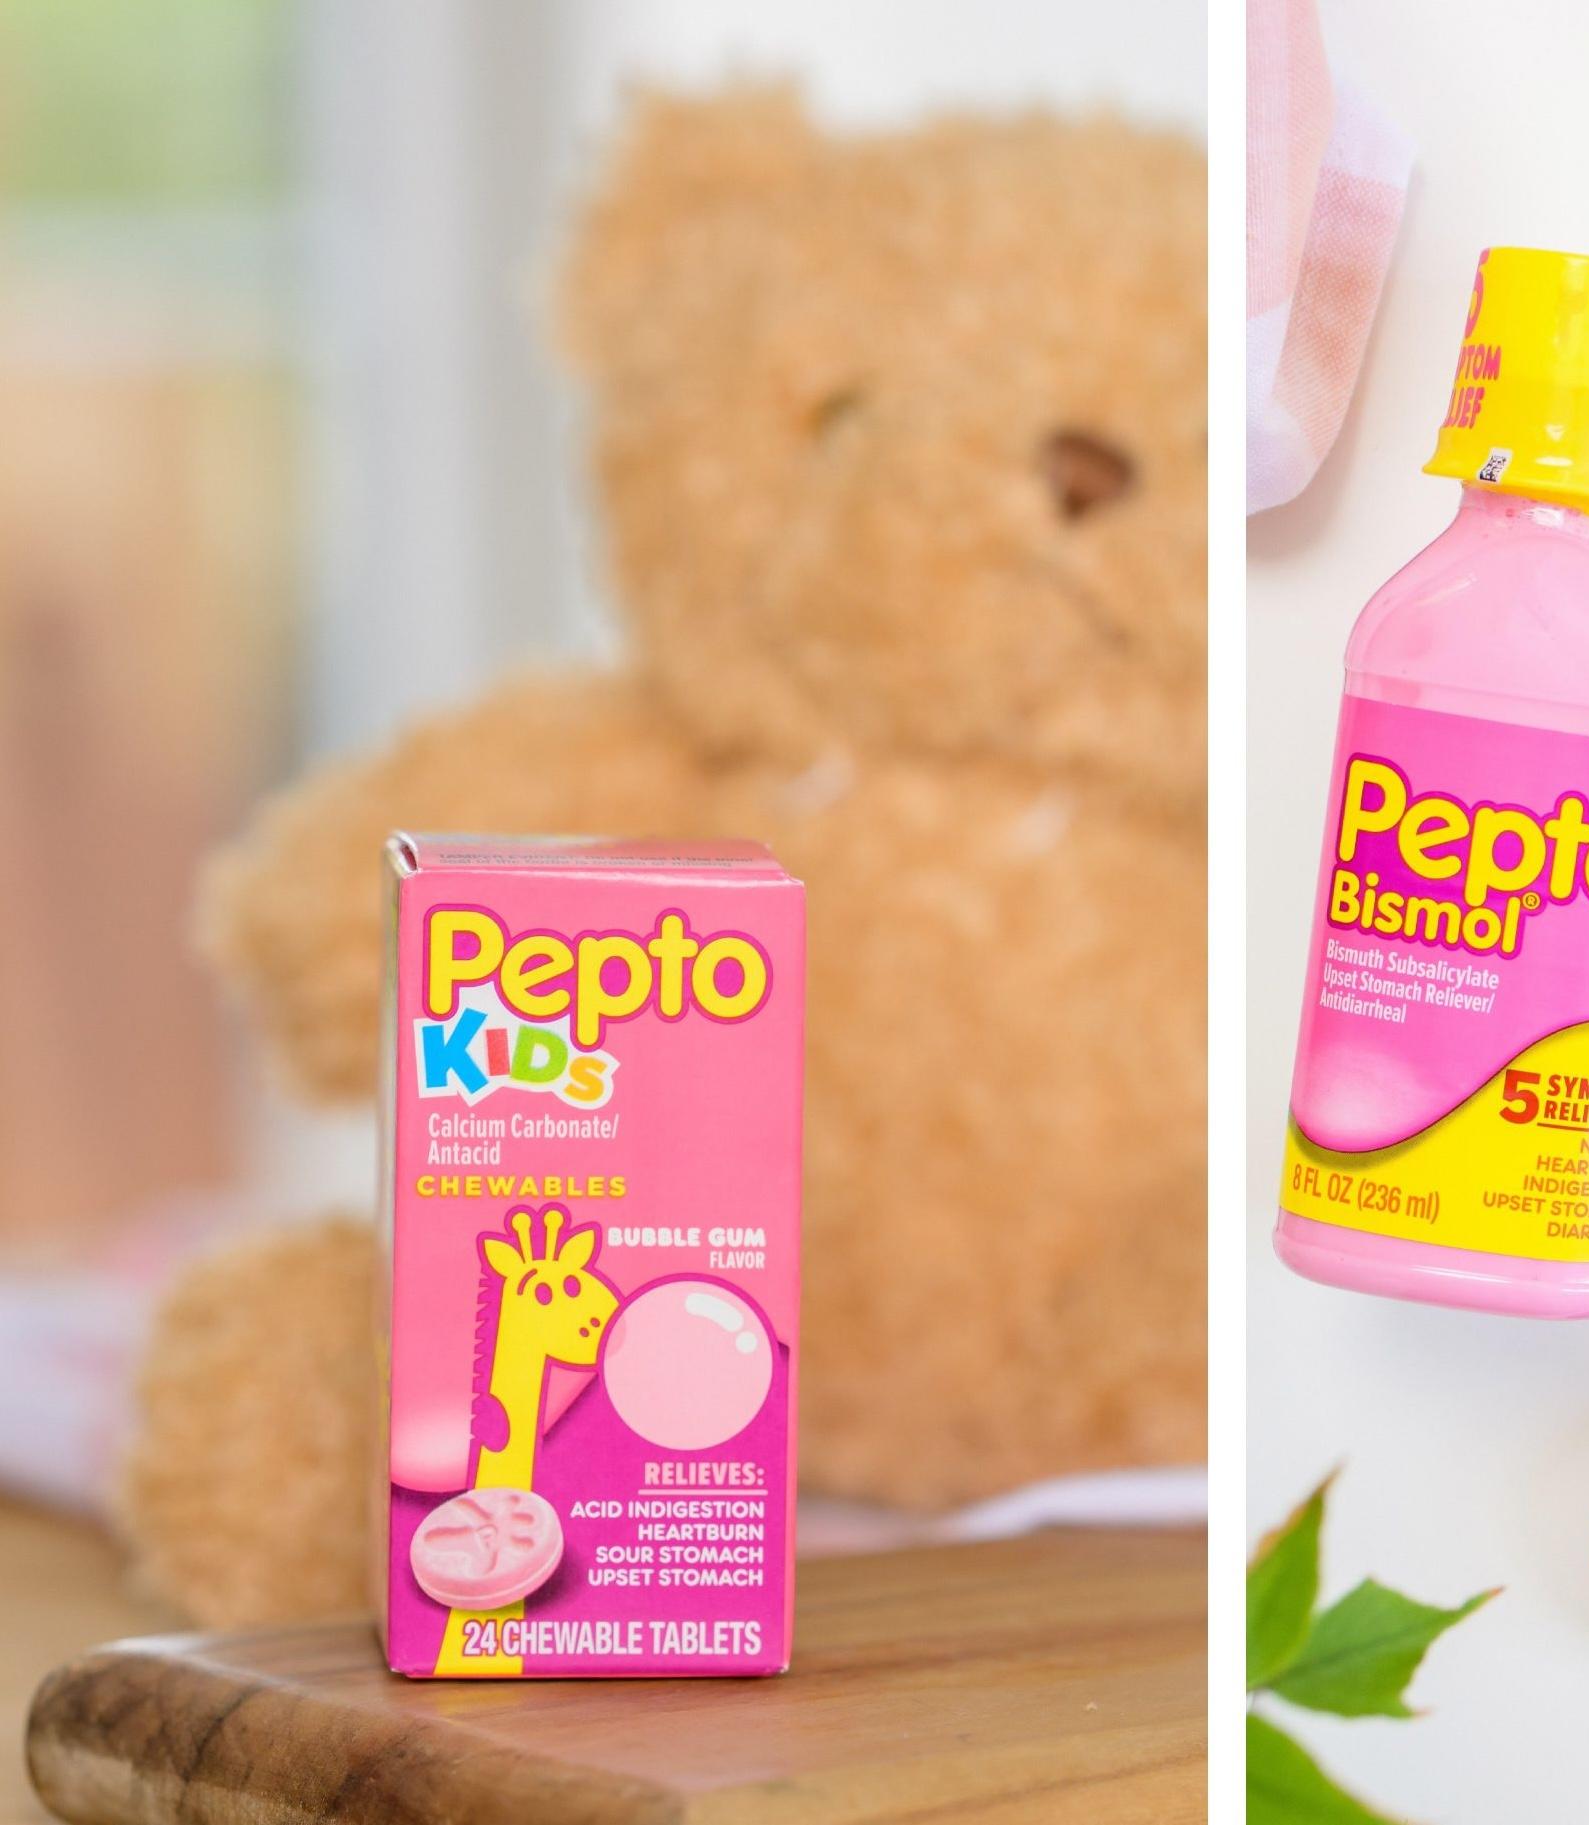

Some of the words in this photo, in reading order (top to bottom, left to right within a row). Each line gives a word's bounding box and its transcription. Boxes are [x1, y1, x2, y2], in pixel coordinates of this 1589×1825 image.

[1326, 939, 1384, 970] Bismuth
[1386, 951, 1500, 990] Subsalicylate
[427, 909, 769, 1047] Pepto
[1323, 962, 1358, 990] Upset
[1359, 971, 1422, 1002] Stomach
[1424, 983, 1496, 1014] Reliever/
[1319, 987, 1407, 1024] Antidiarrheal
[421, 1007, 607, 1102] KIDS
[1499, 1069, 1541, 1125] 5
[428, 1113, 506, 1139] Calcium
[510, 1113, 620, 1141] Carbonate/
[427, 1140, 501, 1166] Antacid
[415, 1175, 627, 1198] CHEWABLES
[1292, 1163, 1303, 1191] 8
[1303, 1166, 1322, 1198] FL
[1327, 1172, 1354, 1204] OZ
[1357, 1178, 1402, 1214] (236
[1405, 1191, 1441, 1225] ml)
[1482, 1191, 1546, 1214] UPSET
[607, 1227, 701, 1248] BUBBLE
[707, 1227, 767, 1248] GUM
[709, 1251, 766, 1270] FLAVOR
[644, 1462, 765, 1486] RELIEVES:
[570, 1501, 623, 1519] ACID
[627, 1501, 765, 1519] INDIGESTION
[638, 1523, 764, 1541] HEARTBURN
[595, 1546, 654, 1564] SOUR
[658, 1546, 764, 1564] STOMACH
[588, 1568, 655, 1587] UPSET
[658, 1568, 764, 1587] STOMACH
[462, 1620, 497, 1656] 24
[501, 1620, 644, 1656] CHEWABLE
[649, 1620, 762, 1656] TABLETS
